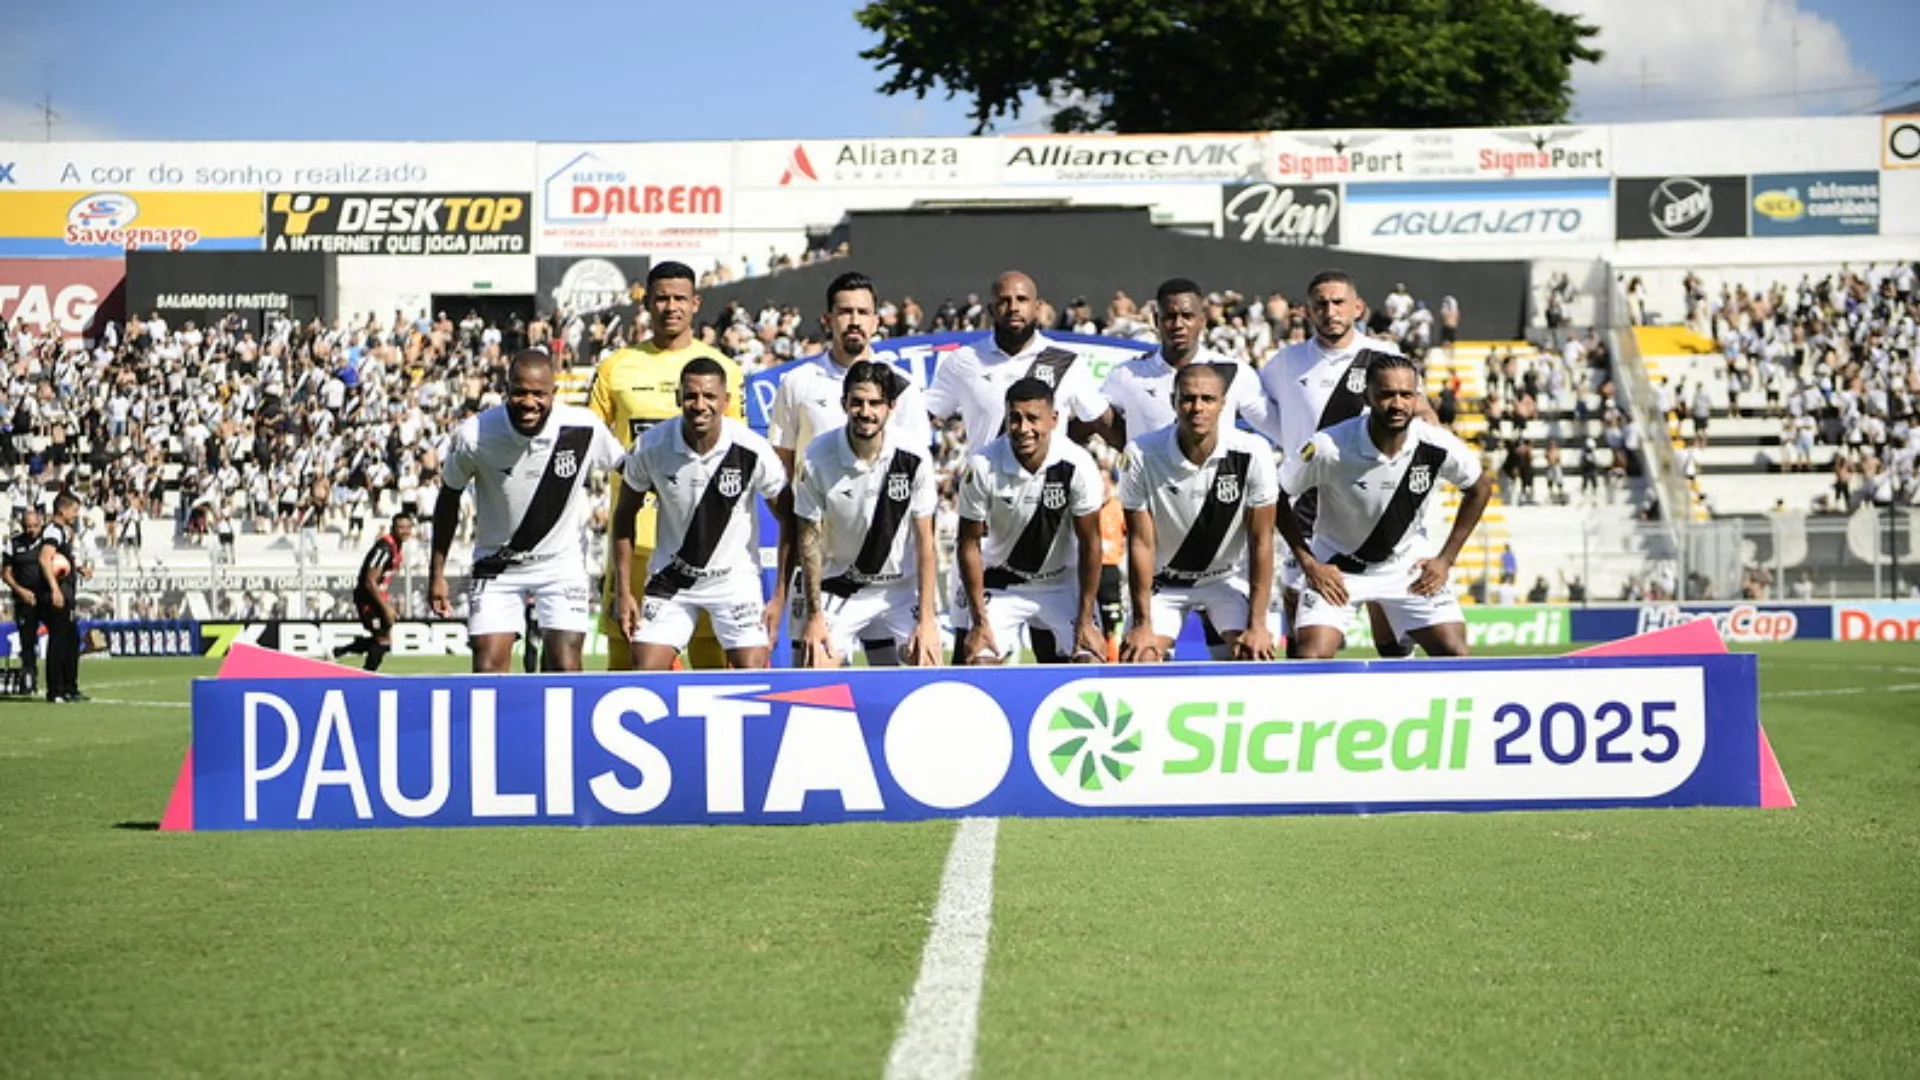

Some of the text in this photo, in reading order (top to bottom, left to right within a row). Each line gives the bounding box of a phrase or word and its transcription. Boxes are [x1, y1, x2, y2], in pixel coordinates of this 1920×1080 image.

[835, 143, 958, 165] Alianza
[1278, 149, 1403, 180] SigmaPort
[1478, 147, 1603, 177] SigmaPort
[60, 161, 427, 185] A cor do sonho realizado
[571, 185, 722, 214] DALBEM
[336, 198, 523, 233] DESKTOP
[1371, 208, 1583, 236] AGUAJATO
[66, 226, 198, 251] Savegnago
[273, 234, 523, 254] A INTERNET QUE JOGA JUNTO
[157, 294, 225, 309] SALGADOS
[1161, 697, 1681, 775] Sicredi 2025
